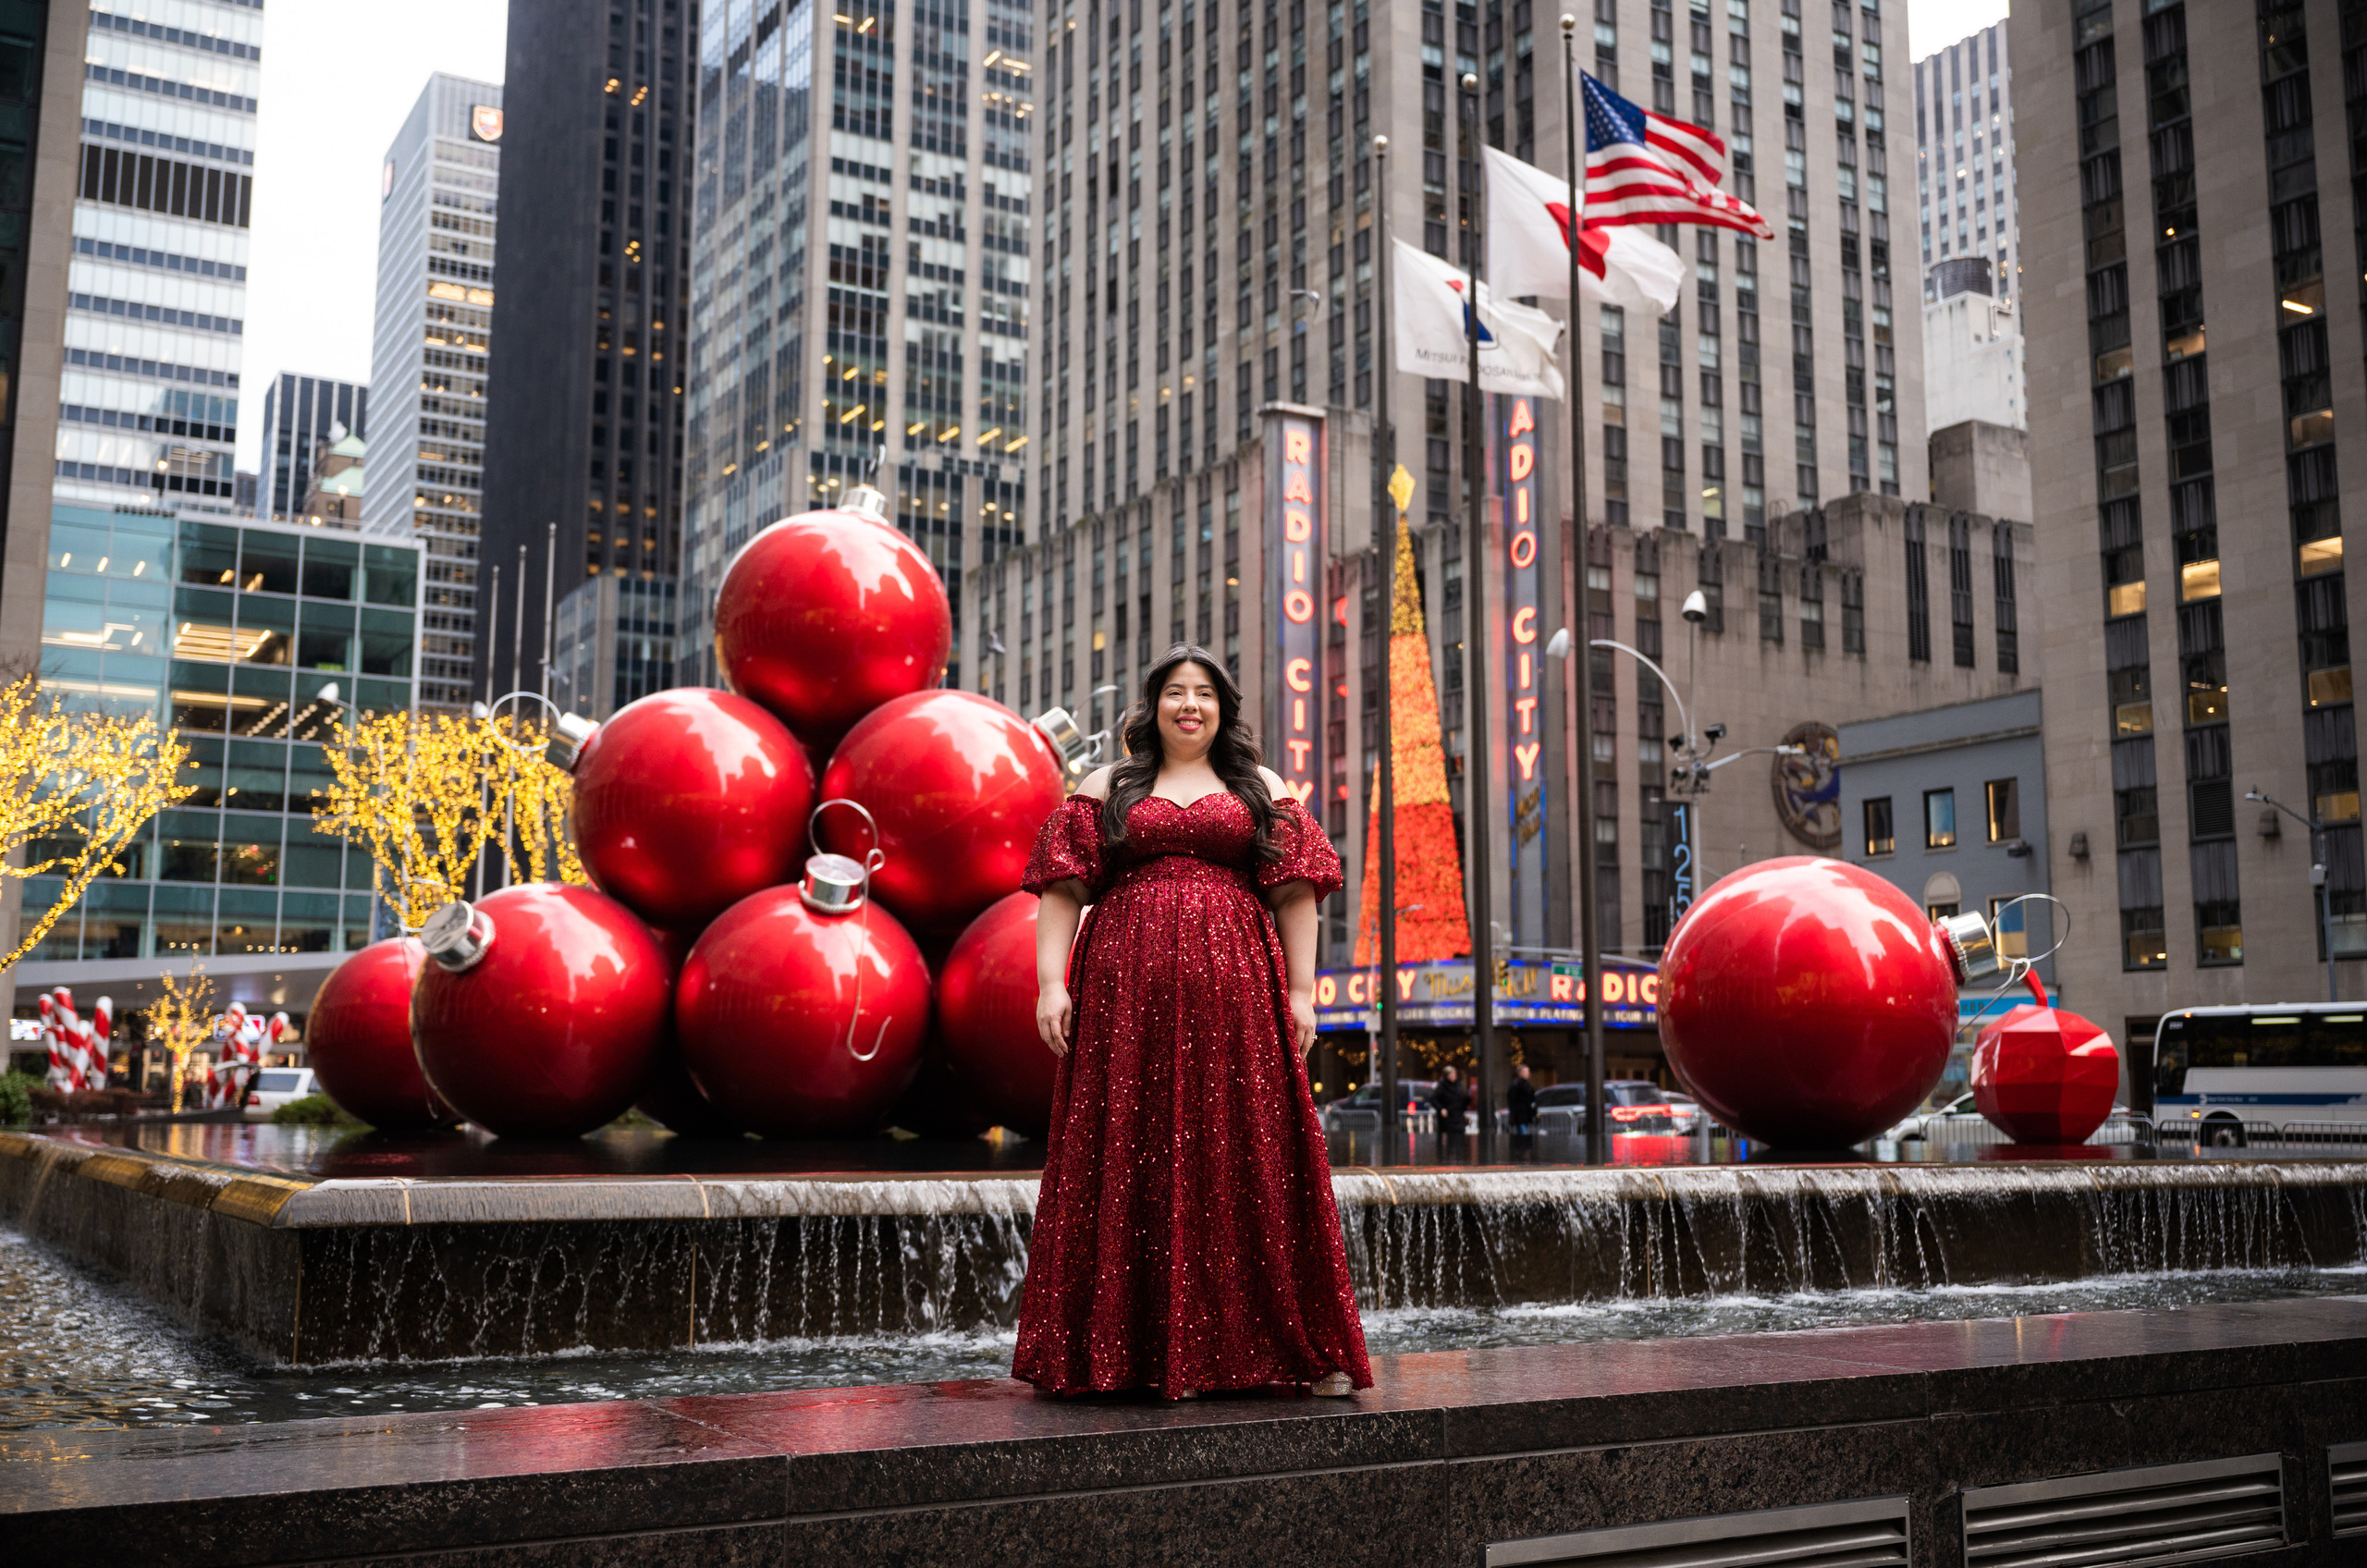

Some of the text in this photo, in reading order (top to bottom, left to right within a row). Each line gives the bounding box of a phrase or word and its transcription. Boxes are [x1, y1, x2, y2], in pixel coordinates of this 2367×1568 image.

[1510, 398, 1537, 569] ADIO
[1283, 429, 1314, 807] RADIO CITY
[1513, 606, 1540, 781] CITY
[1347, 969, 1417, 1004] CIY
[1962, 1000, 1985, 1014] KER
